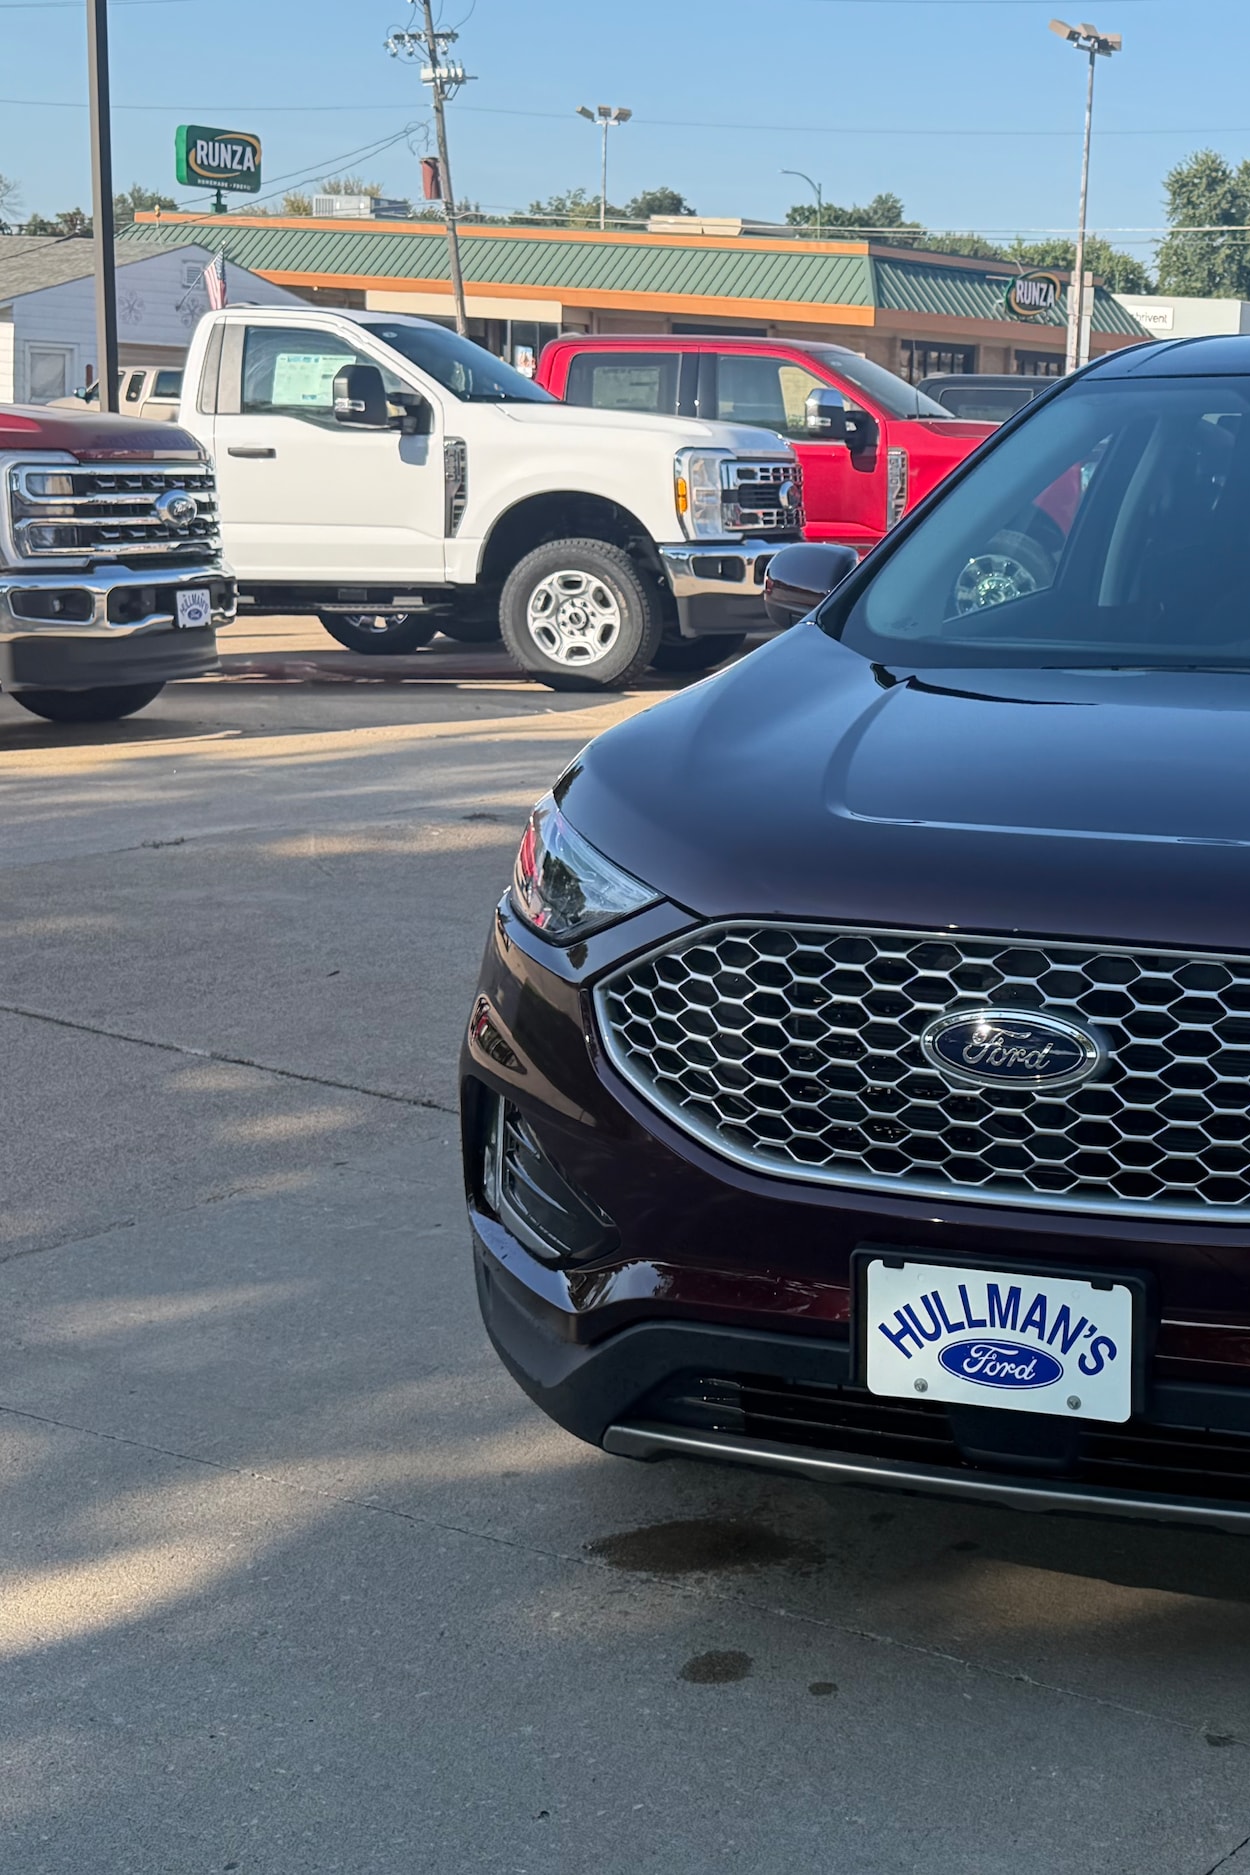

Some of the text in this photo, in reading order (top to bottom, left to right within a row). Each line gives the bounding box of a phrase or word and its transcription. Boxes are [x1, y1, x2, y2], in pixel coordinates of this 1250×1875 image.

[196, 139, 255, 172] RUNZA
[1015, 279, 1056, 308] RUNZA
[1135, 311, 1168, 324] hrivent
[962, 1024, 1054, 1070] Ford
[878, 1283, 1118, 1376] HULLMAN'S
[962, 1343, 1036, 1381] Ford
